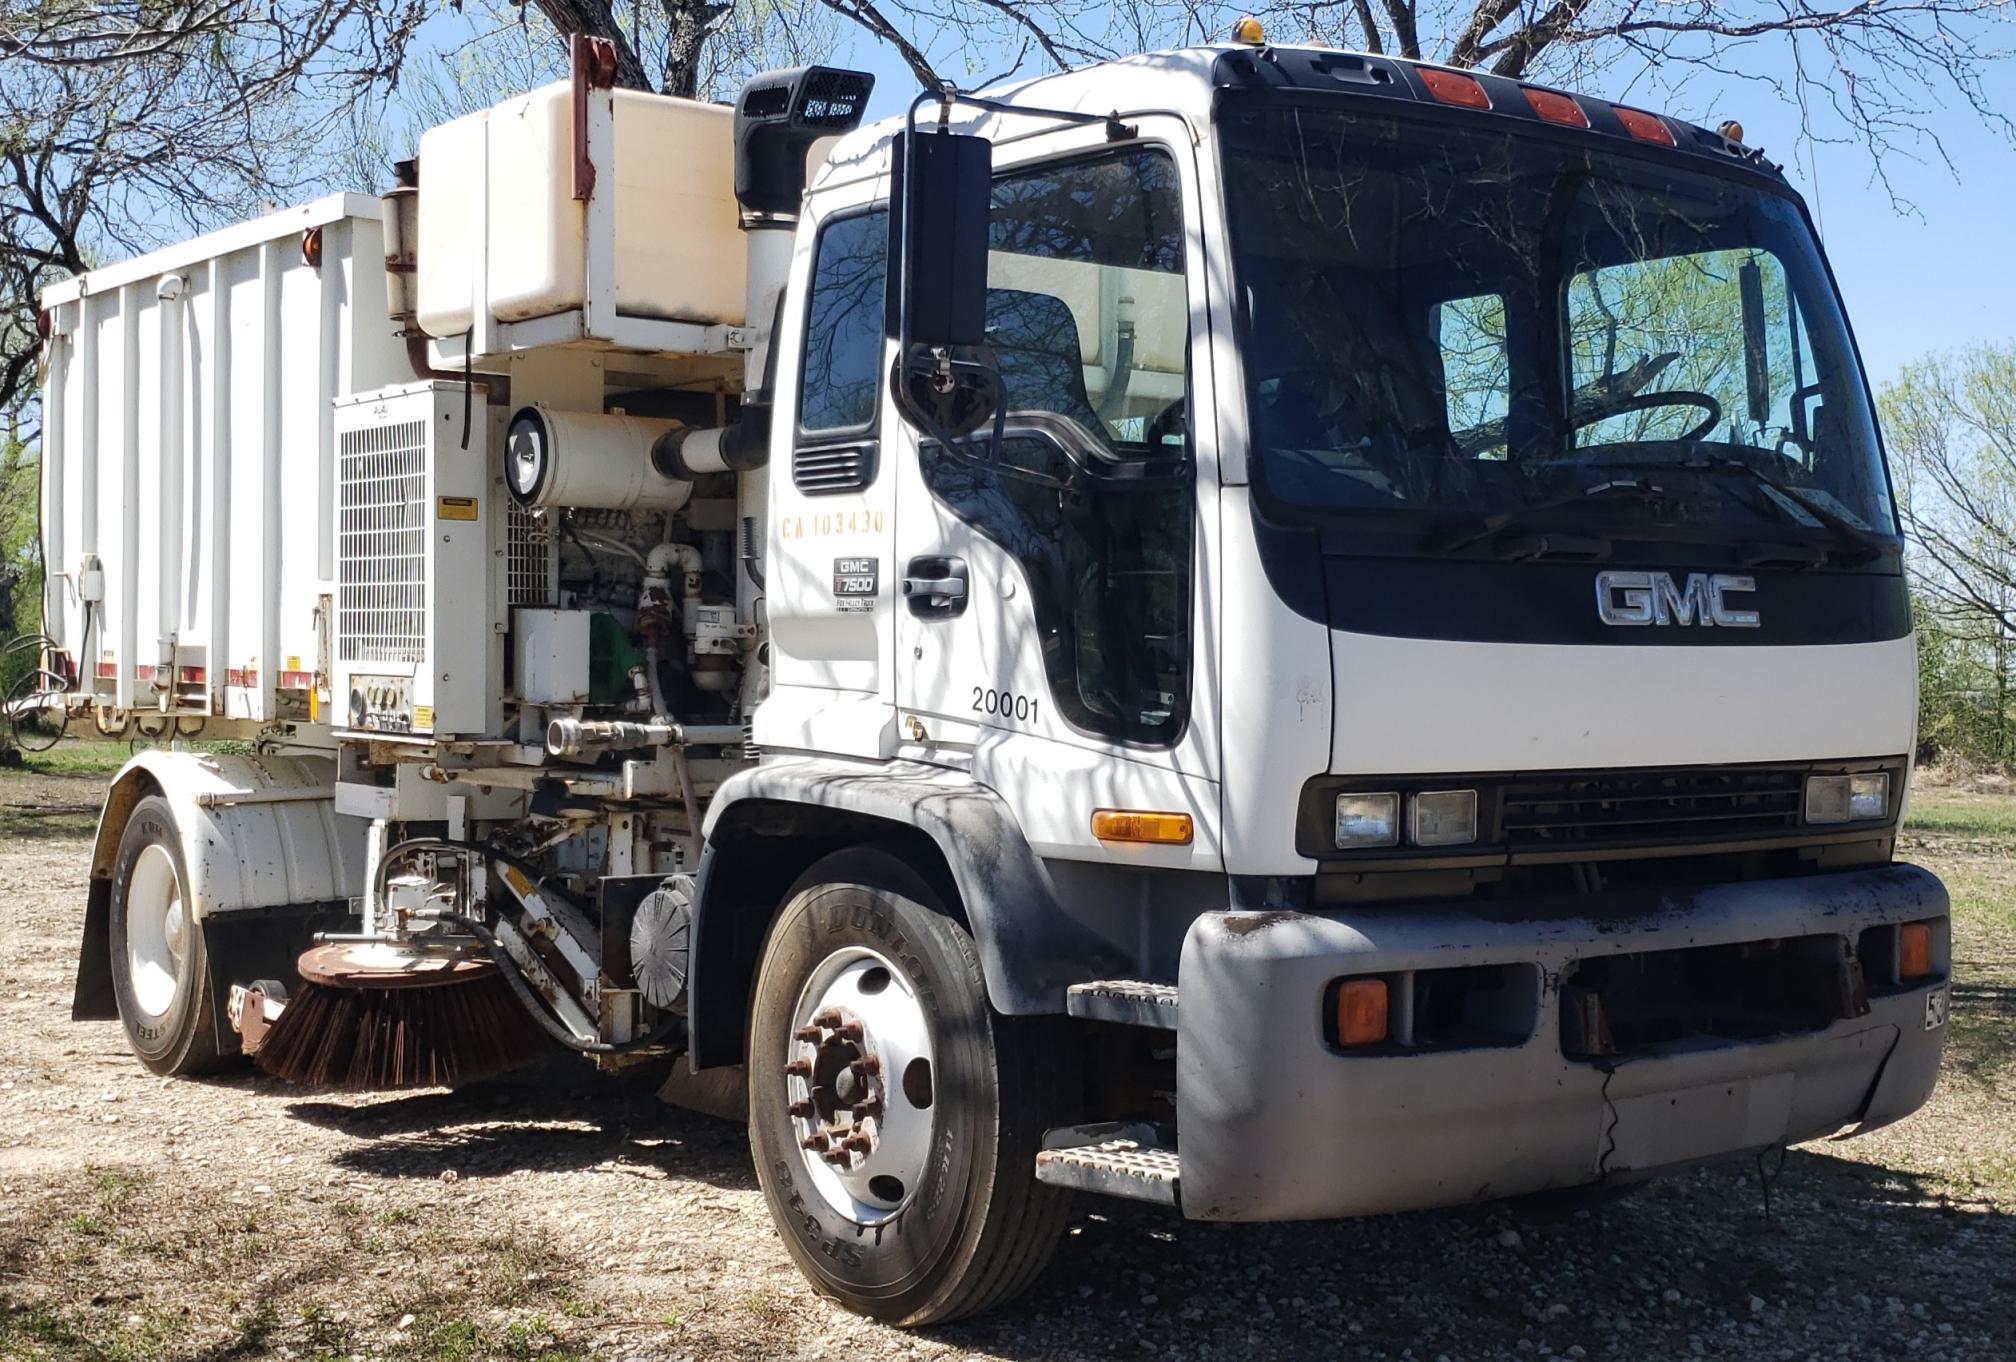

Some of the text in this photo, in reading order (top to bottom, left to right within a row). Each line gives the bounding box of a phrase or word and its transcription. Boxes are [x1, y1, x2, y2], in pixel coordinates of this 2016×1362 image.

[782, 509, 883, 539] CA 103430
[840, 561, 869, 573] GMC
[1595, 570, 1761, 628] GMC
[972, 686, 1038, 724] 20001
[828, 904, 941, 1013] DUNLOP
